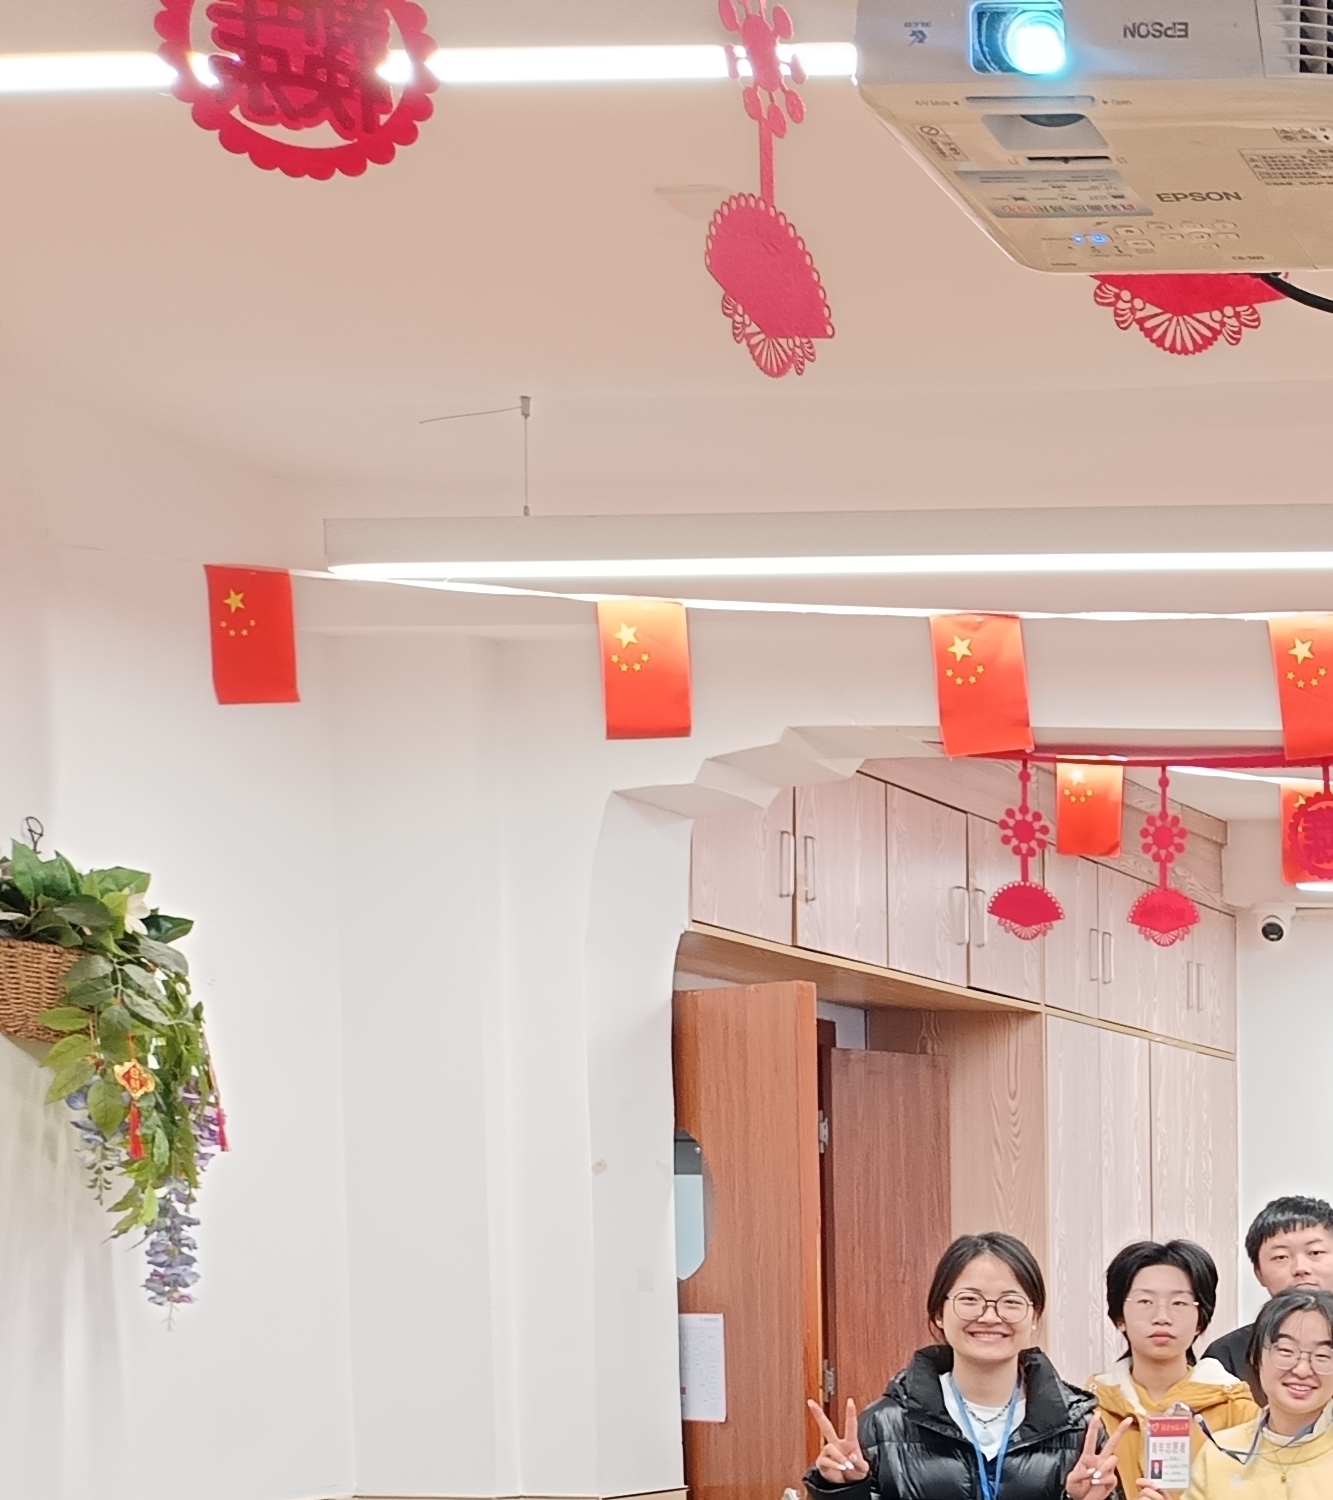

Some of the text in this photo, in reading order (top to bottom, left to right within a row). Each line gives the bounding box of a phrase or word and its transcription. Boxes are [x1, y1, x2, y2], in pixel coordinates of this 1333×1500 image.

[1123, 21, 1189, 39] EPSON
[1156, 191, 1243, 203] EPSON
[1152, 1442, 1186, 1454] 青年志愿者
